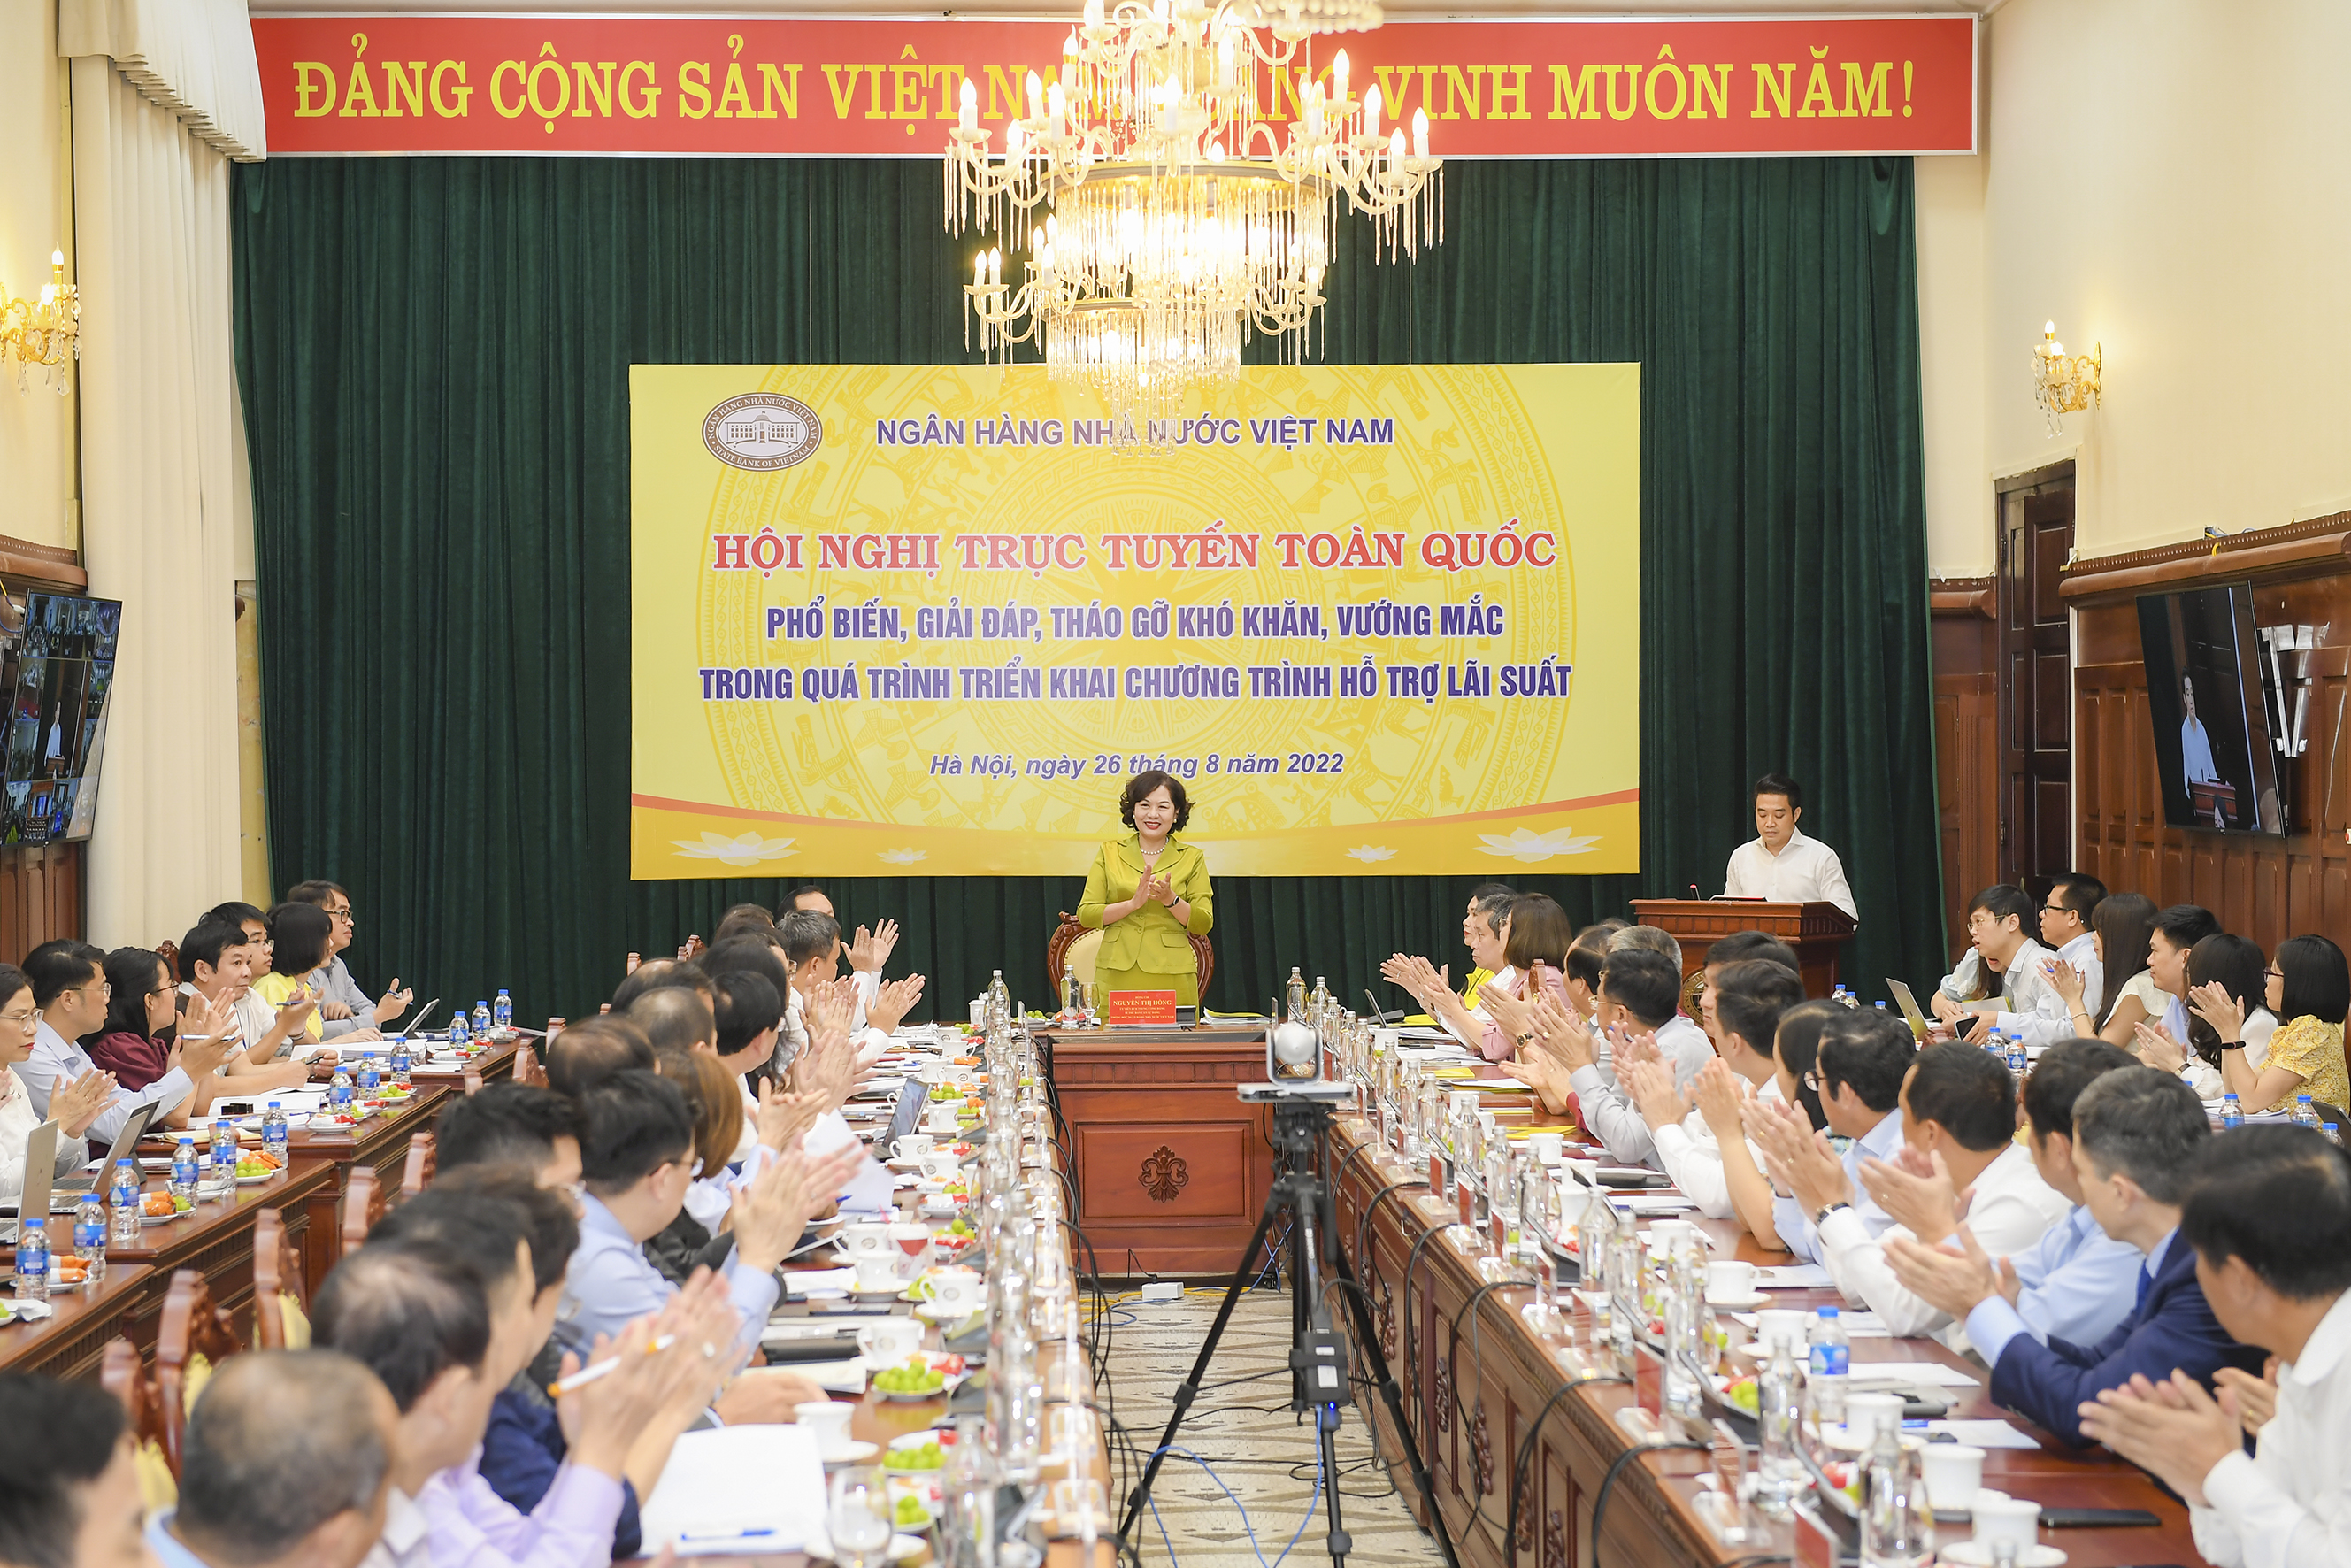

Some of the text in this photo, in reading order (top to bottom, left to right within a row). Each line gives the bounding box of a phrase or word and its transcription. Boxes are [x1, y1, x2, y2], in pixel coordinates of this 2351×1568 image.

[293, 33, 473, 119] ĐẢNG
[489, 41, 662, 134] CỘNG
[678, 34, 803, 119] SẢN
[821, 44, 965, 135] VIỆT
[1373, 65, 1532, 121] VINH
[1548, 43, 1733, 121] MUÔN
[1750, 45, 1915, 119] NĂM!
[718, 400, 743, 416] HÀNG
[744, 396, 764, 405] NHÀ
[807, 419, 818, 439] NAM
[877, 413, 964, 445] NGÂN
[975, 413, 1063, 445] HÀNG
[1249, 415, 1318, 450] VIỆT
[1326, 419, 1394, 444] NAM
[713, 519, 1556, 578] HỘI NGHỊ TRỰC TUYẾN TOÀN QUỐC
[767, 593, 1503, 642] PHỔ BIẾN, GIẢI ĐÁP, THÁO GỠ KHÓ KHĂN, VƯỚNG MẮC
[699, 654, 1571, 703] TRONG QUÁ TRÌNH TRIỂN KHAI CHƯƠNG TRÌNH HỖ TRỢ LÃI SUẤT
[929, 752, 1344, 780] Hà Nội, ngày 26 tháng 8 năm 2022
